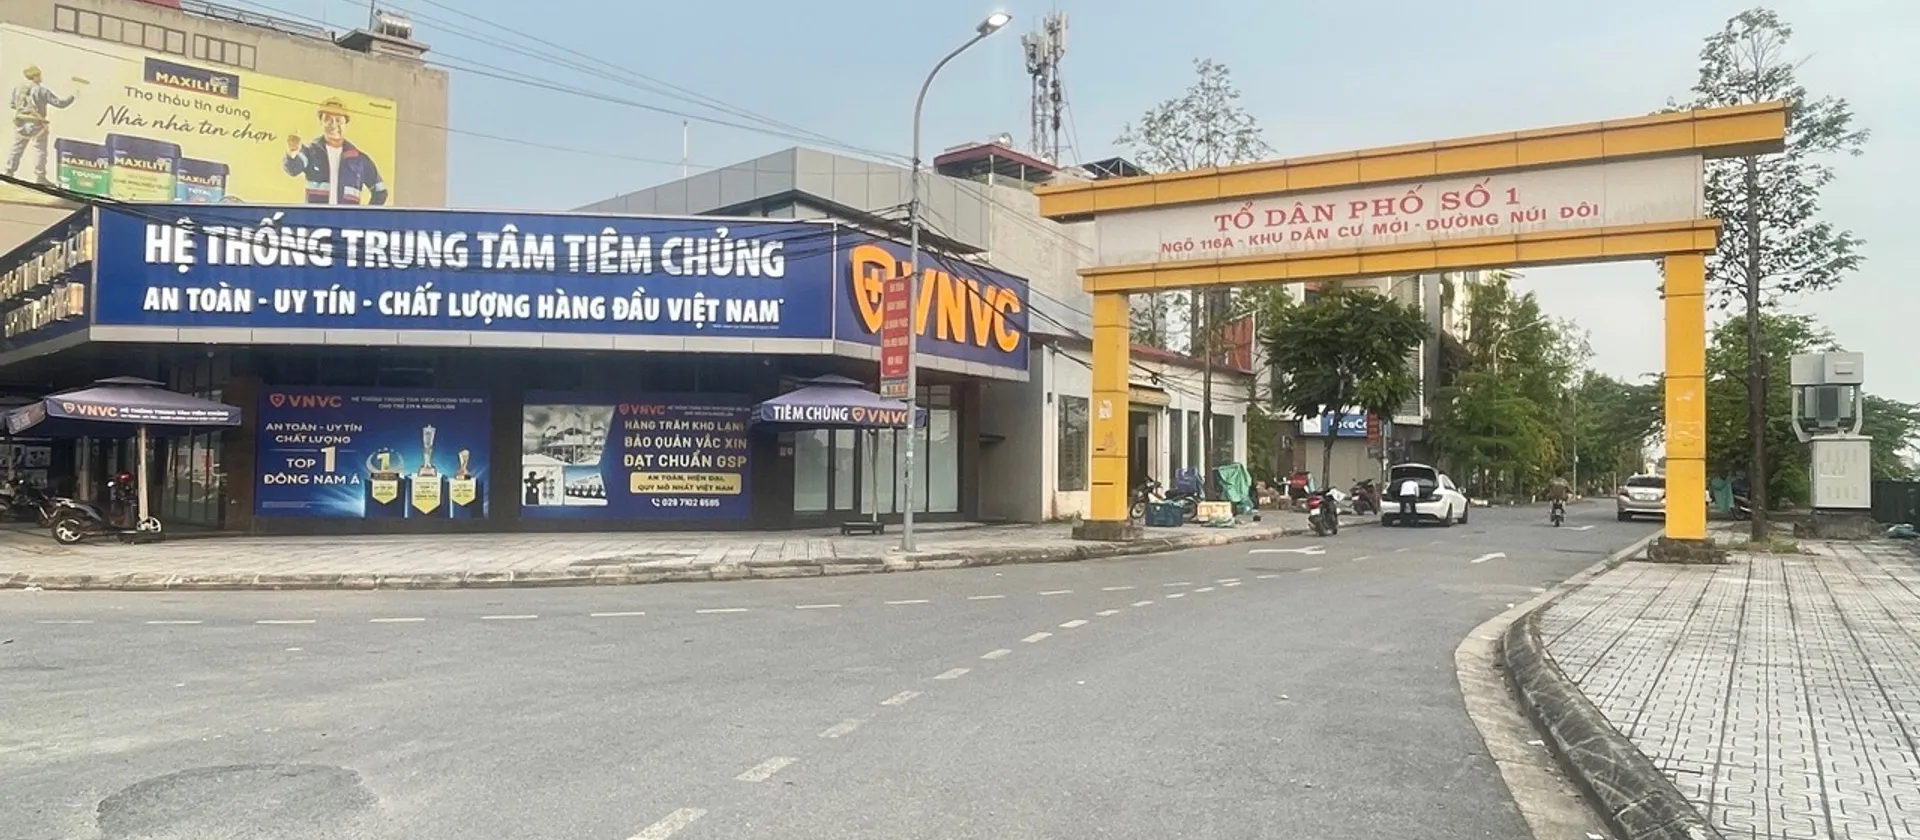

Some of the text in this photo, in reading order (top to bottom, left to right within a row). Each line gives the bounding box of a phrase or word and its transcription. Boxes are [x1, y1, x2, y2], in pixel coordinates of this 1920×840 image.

[155, 71, 229, 95] MAXILITE
[1213, 177, 1521, 232] TỔ DÂN PHỐ SỐ 1
[1200, 238, 1234, 250] 116A
[1249, 232, 1283, 246] KHU
[1291, 226, 1329, 241] DÂN
[1338, 223, 1364, 237] CƯ
[1373, 217, 1408, 235] MỚI
[1511, 206, 1547, 223] NÚI
[145, 216, 198, 274] HỆ
[203, 211, 333, 267] THỐNG
[341, 229, 469, 270] TRUNG
[477, 223, 556, 270] TÂM
[563, 226, 652, 274] TIÊM
[661, 225, 785, 277] CHỦNG
[143, 286, 179, 312] AN
[186, 281, 251, 313] TOÀN
[274, 289, 307, 314] UY
[314, 284, 356, 315] TÍN
[378, 281, 442, 317] CHẤT
[448, 290, 530, 325] LƯỢNG
[538, 287, 606, 320] HÀNG
[612, 286, 660, 321] ĐẦU
[667, 292, 720, 329] VIỆT
[902, 261, 1021, 352] VNVC
[288, 395, 342, 408] VNVC
[631, 404, 665, 415] VNVC
[77, 404, 118, 417] VNVC
[772, 404, 804, 421] TIÊM
[806, 404, 849, 421] CHỦNG
[266, 423, 283, 431] AN
[285, 422, 317, 432] TOÀN
[326, 424, 342, 432] UY
[344, 423, 363, 432] TÍN
[624, 419, 656, 430] HÀNG
[692, 421, 715, 431] KHO
[275, 433, 351, 445] CHẤT LƯỢNG
[624, 433, 747, 449] BẢO QUẢN VẮC XIN
[286, 446, 336, 472] TOP 1
[624, 449, 747, 470] ĐẠT CHUẨN GSP
[264, 472, 360, 484] ĐÔNG NAM Á
